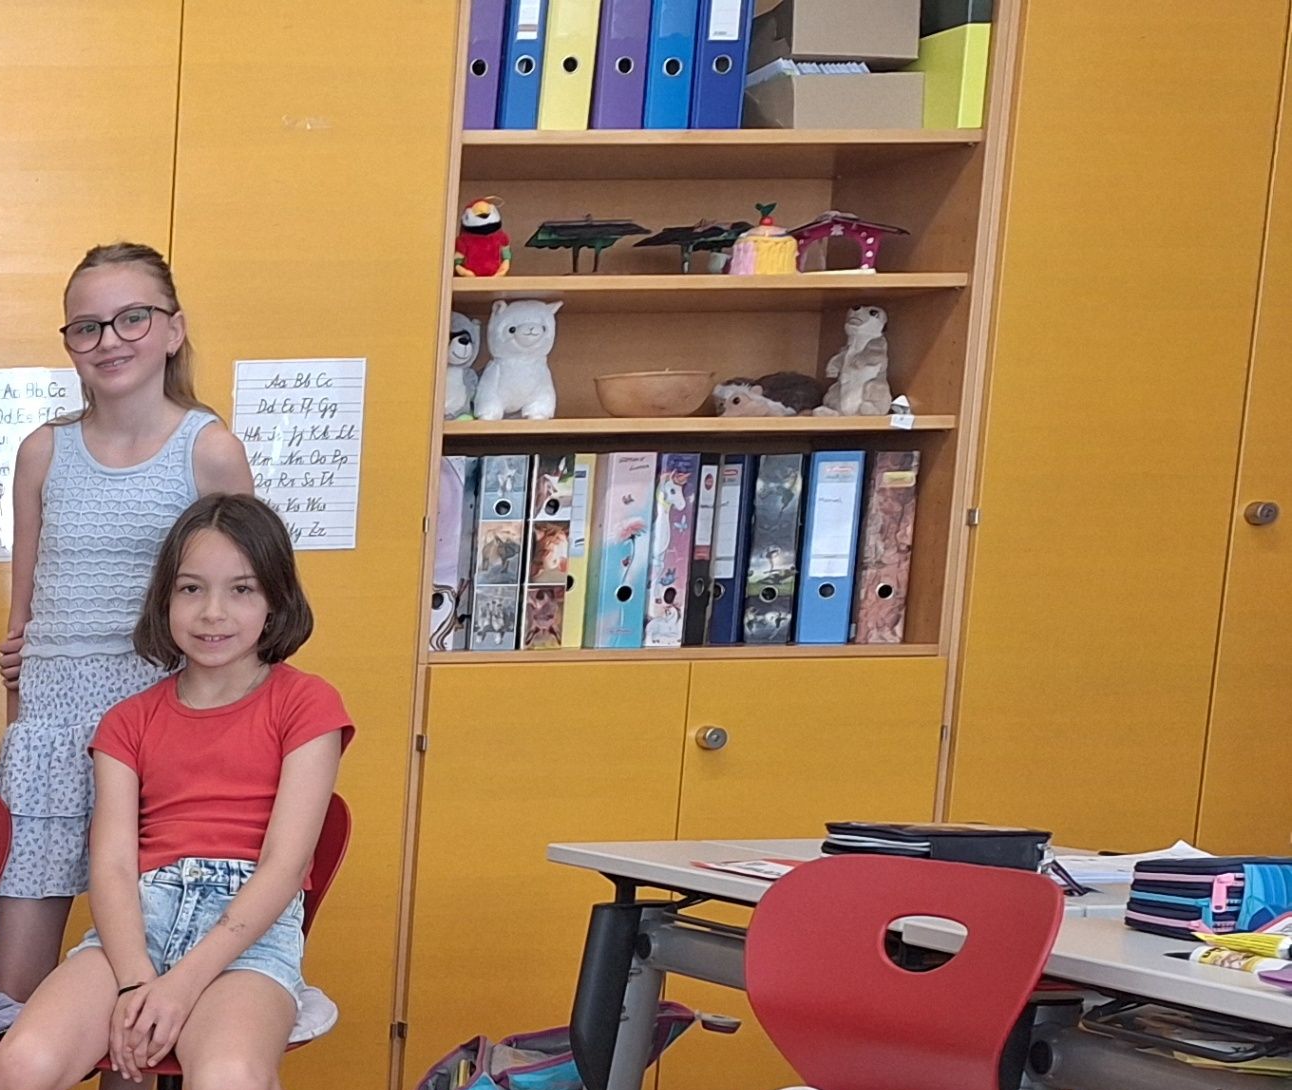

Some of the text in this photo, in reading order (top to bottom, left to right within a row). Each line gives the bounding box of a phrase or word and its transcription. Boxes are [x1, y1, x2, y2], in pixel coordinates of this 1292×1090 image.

[265, 372, 332, 389] Aa Bb Cc
[48, 382, 66, 397] Cc
[257, 398, 275, 414] Dd
[318, 397, 338, 419] Gg
